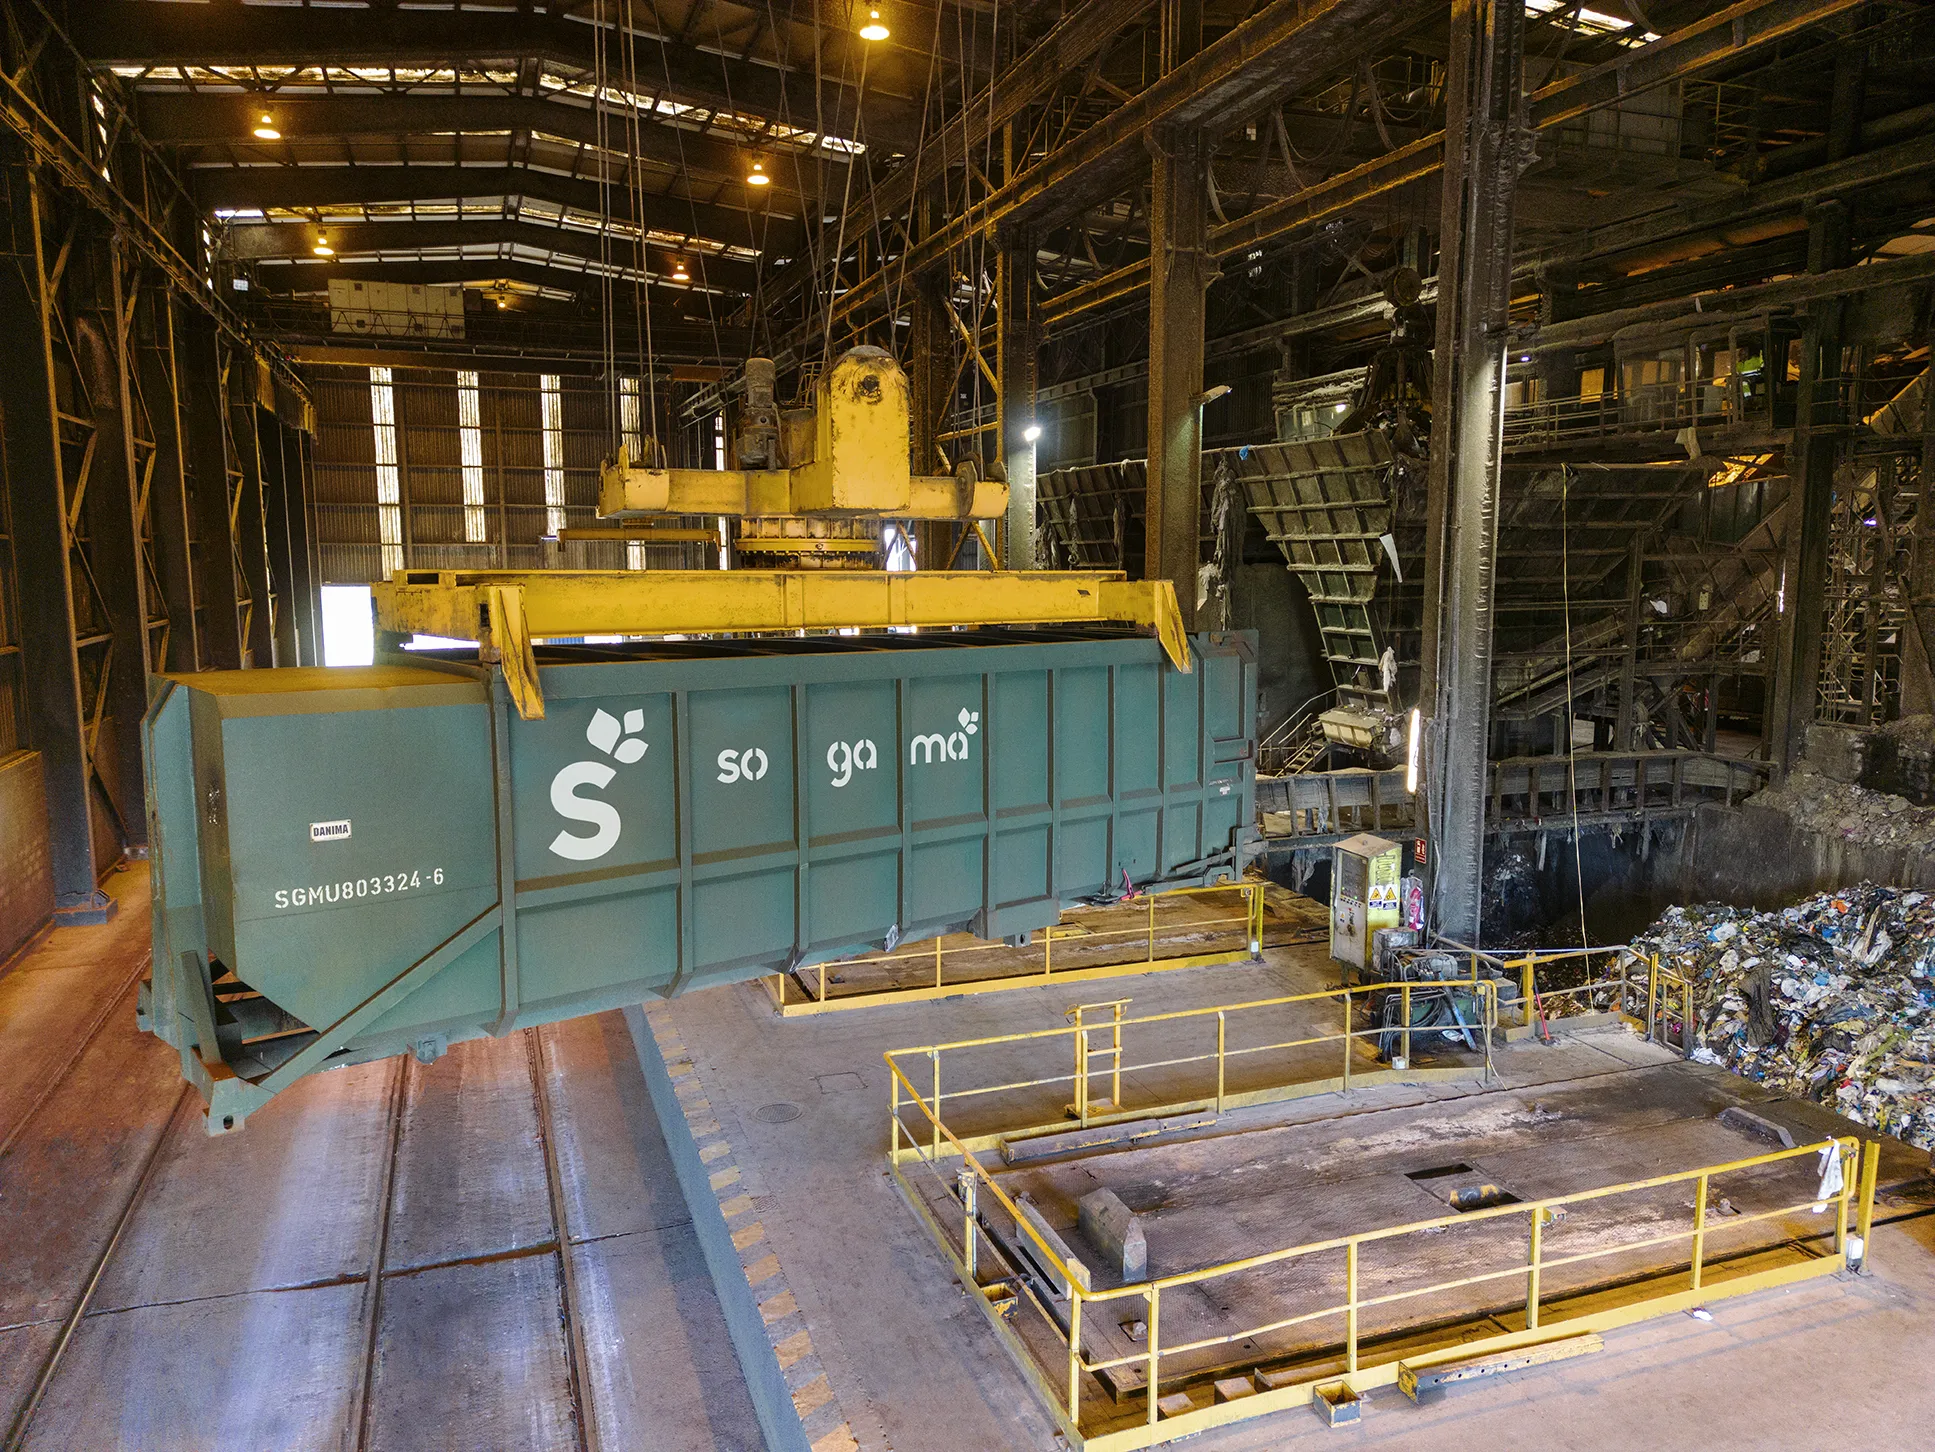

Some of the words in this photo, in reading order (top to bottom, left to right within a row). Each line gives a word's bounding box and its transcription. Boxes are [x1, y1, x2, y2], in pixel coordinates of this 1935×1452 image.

[716, 748, 769, 784] so
[826, 739, 877, 788] ga
[313, 824, 349, 837] DANIMA
[549, 761, 621, 861] S
